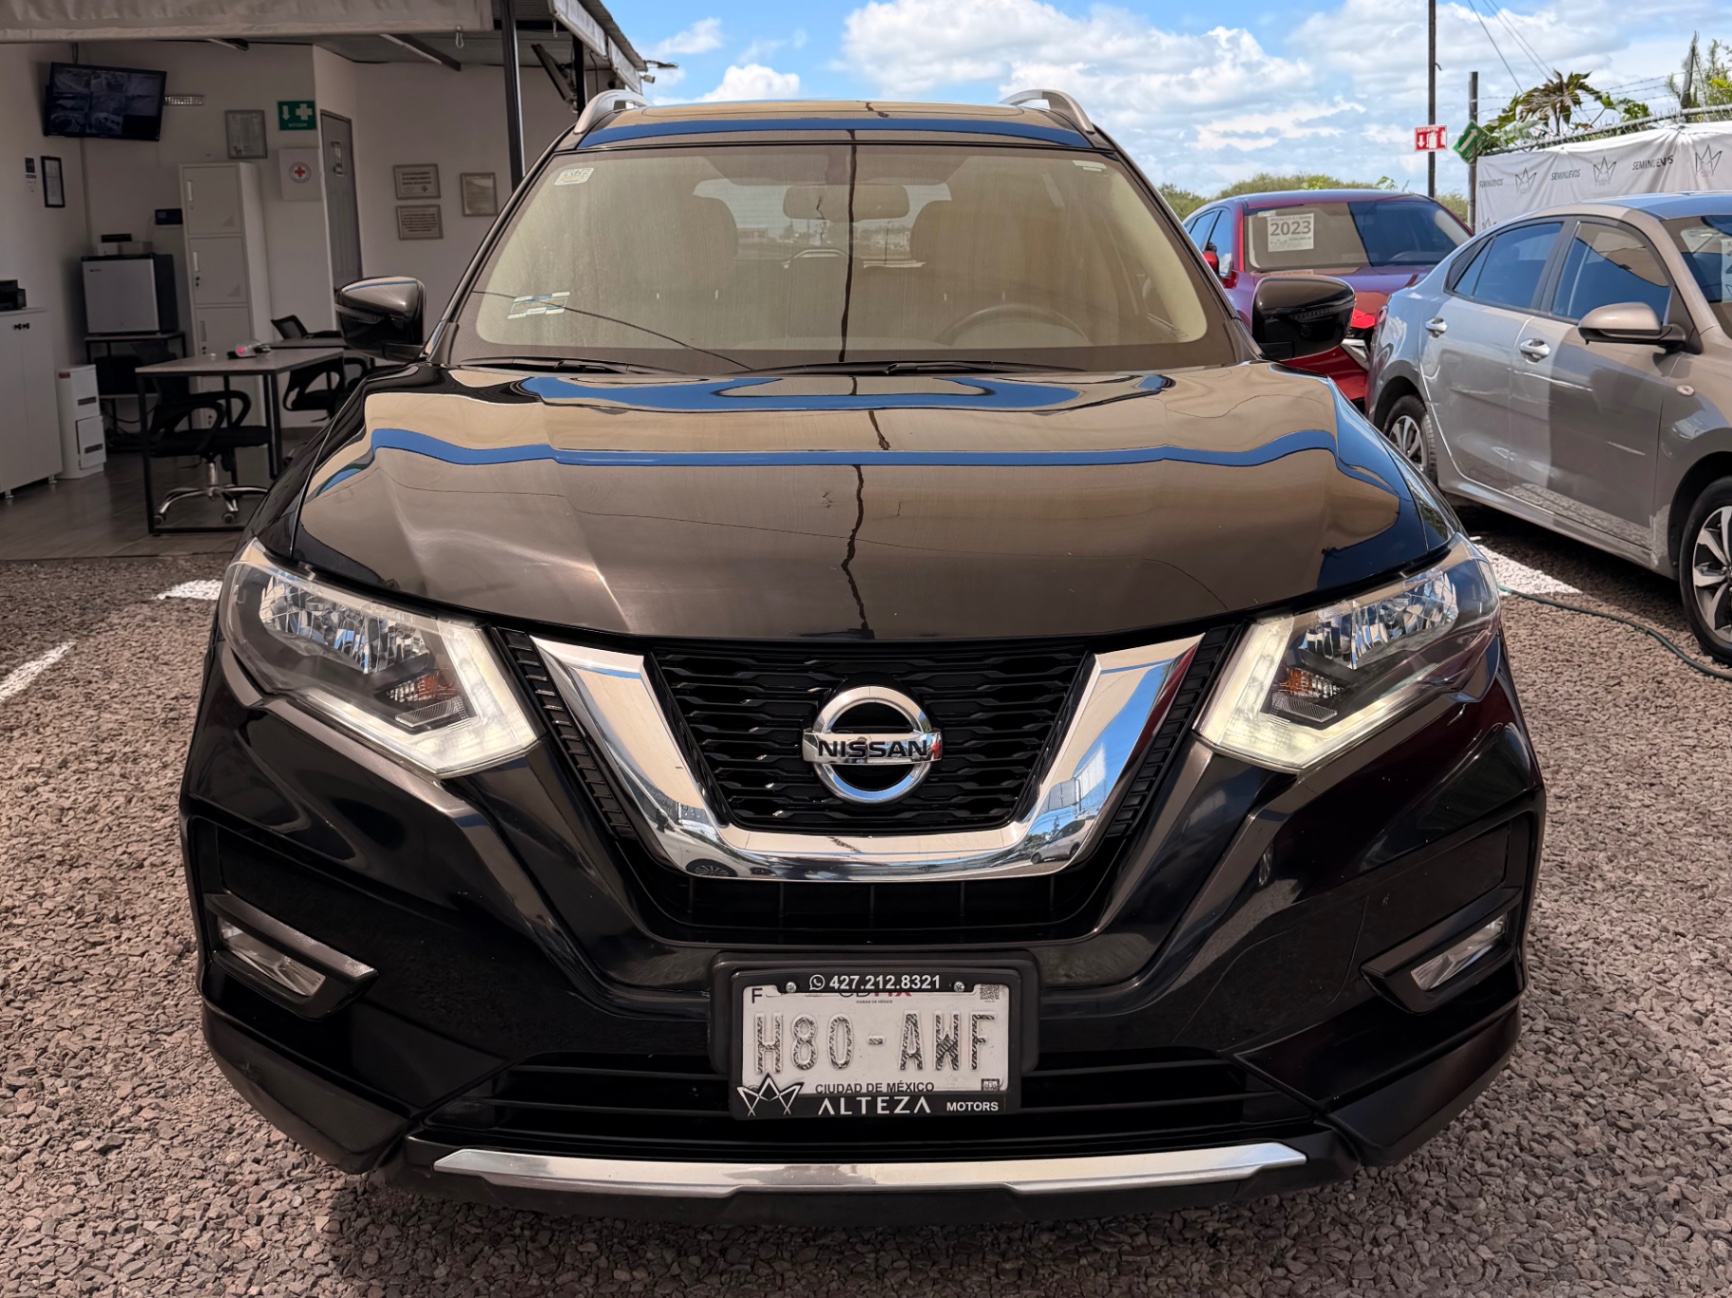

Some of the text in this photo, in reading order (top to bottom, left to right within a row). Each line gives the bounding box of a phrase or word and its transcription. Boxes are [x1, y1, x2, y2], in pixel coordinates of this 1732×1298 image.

[1270, 220, 1311, 236] 2023
[818, 740, 927, 758] NISSAN
[829, 974, 940, 990] 427.212.8321
[751, 988, 763, 1004] F
[815, 1080, 935, 1094] CIUDAD DE MÉXICO
[818, 1096, 999, 1115] ALTEZA MOTORS
